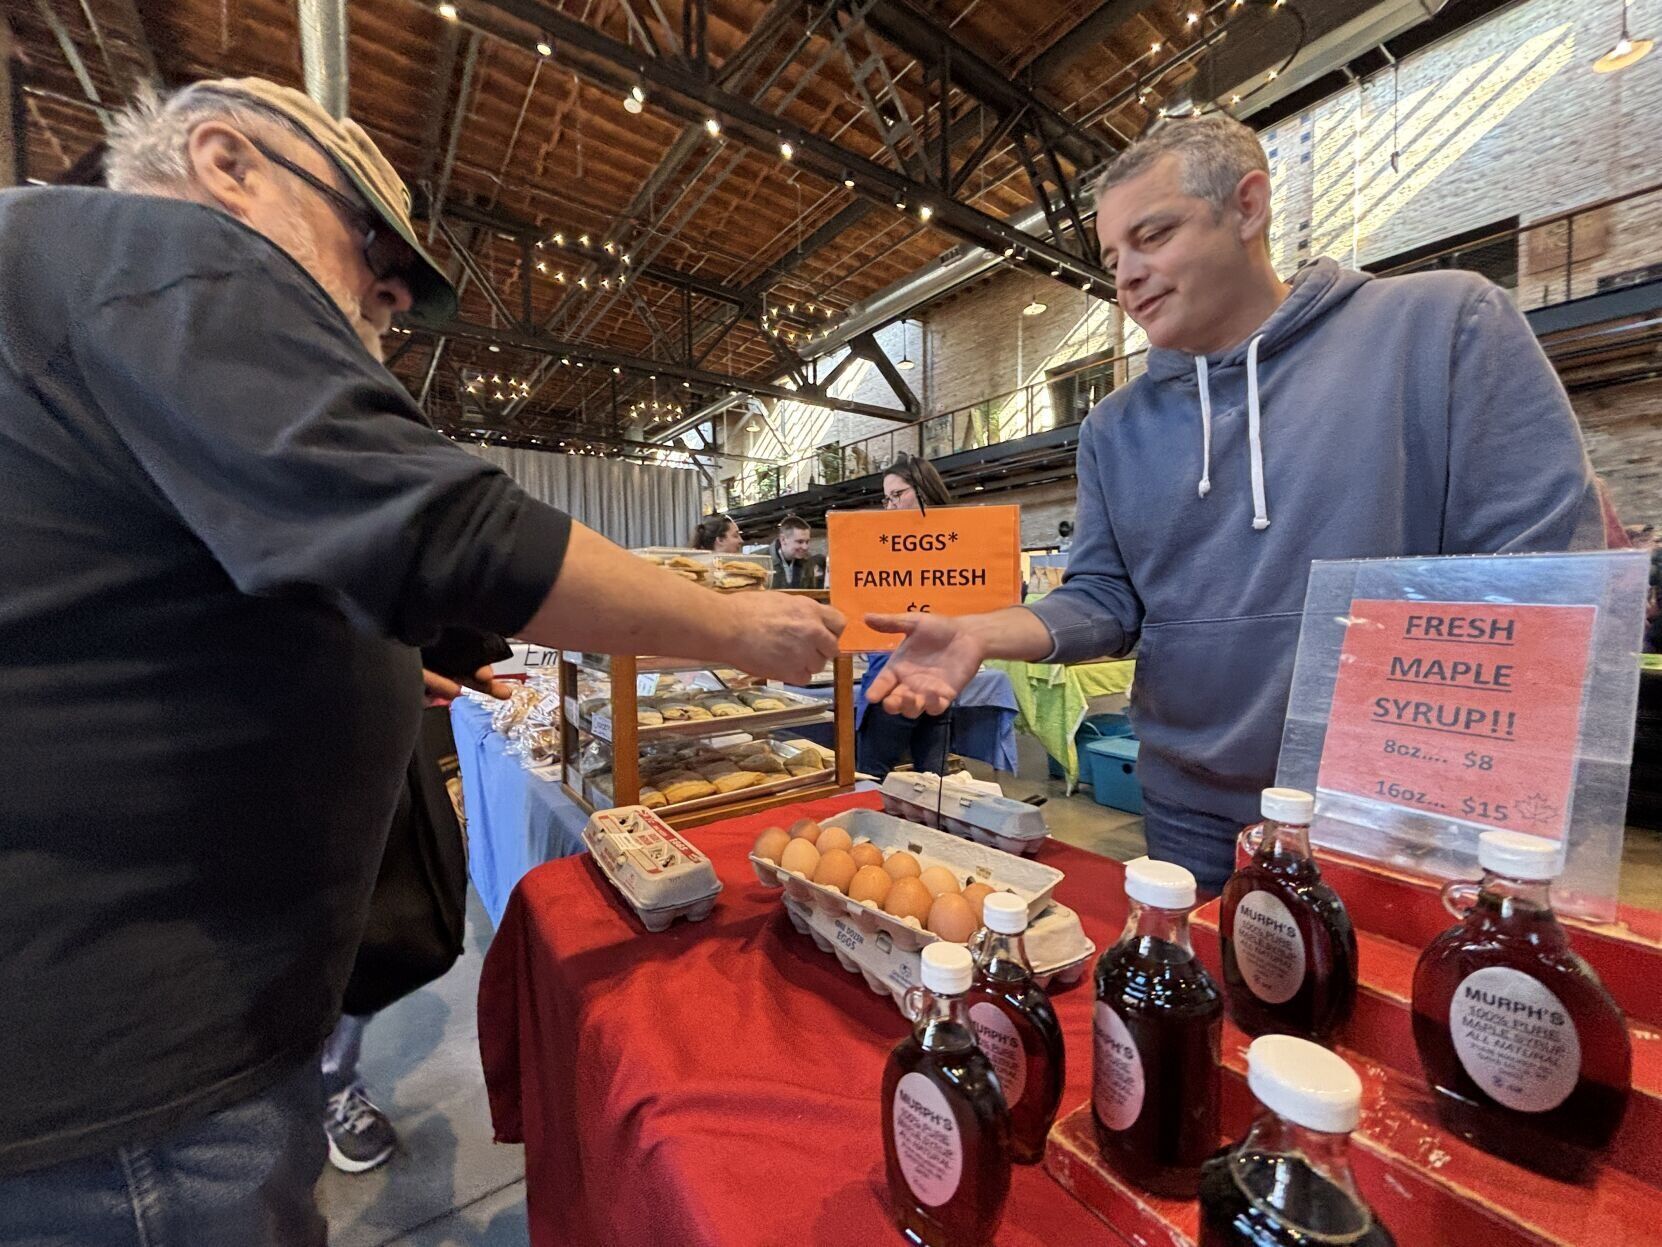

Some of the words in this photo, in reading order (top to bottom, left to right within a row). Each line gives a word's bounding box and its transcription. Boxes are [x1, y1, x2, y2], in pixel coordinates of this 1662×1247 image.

[854, 570, 913, 587] FARM
[920, 568, 986, 586] FRESH
[1405, 615, 1515, 641] FRESH
[1390, 656, 1514, 687] MAPLE
[1373, 697, 1516, 735] SYRUP!!
[1462, 750, 1494, 771] $8
[1461, 796, 1510, 821] $15
[1240, 905, 1296, 938] MURPH'S
[836, 931, 856, 950] EGGS
[1465, 987, 1565, 1026] MURPH'S
